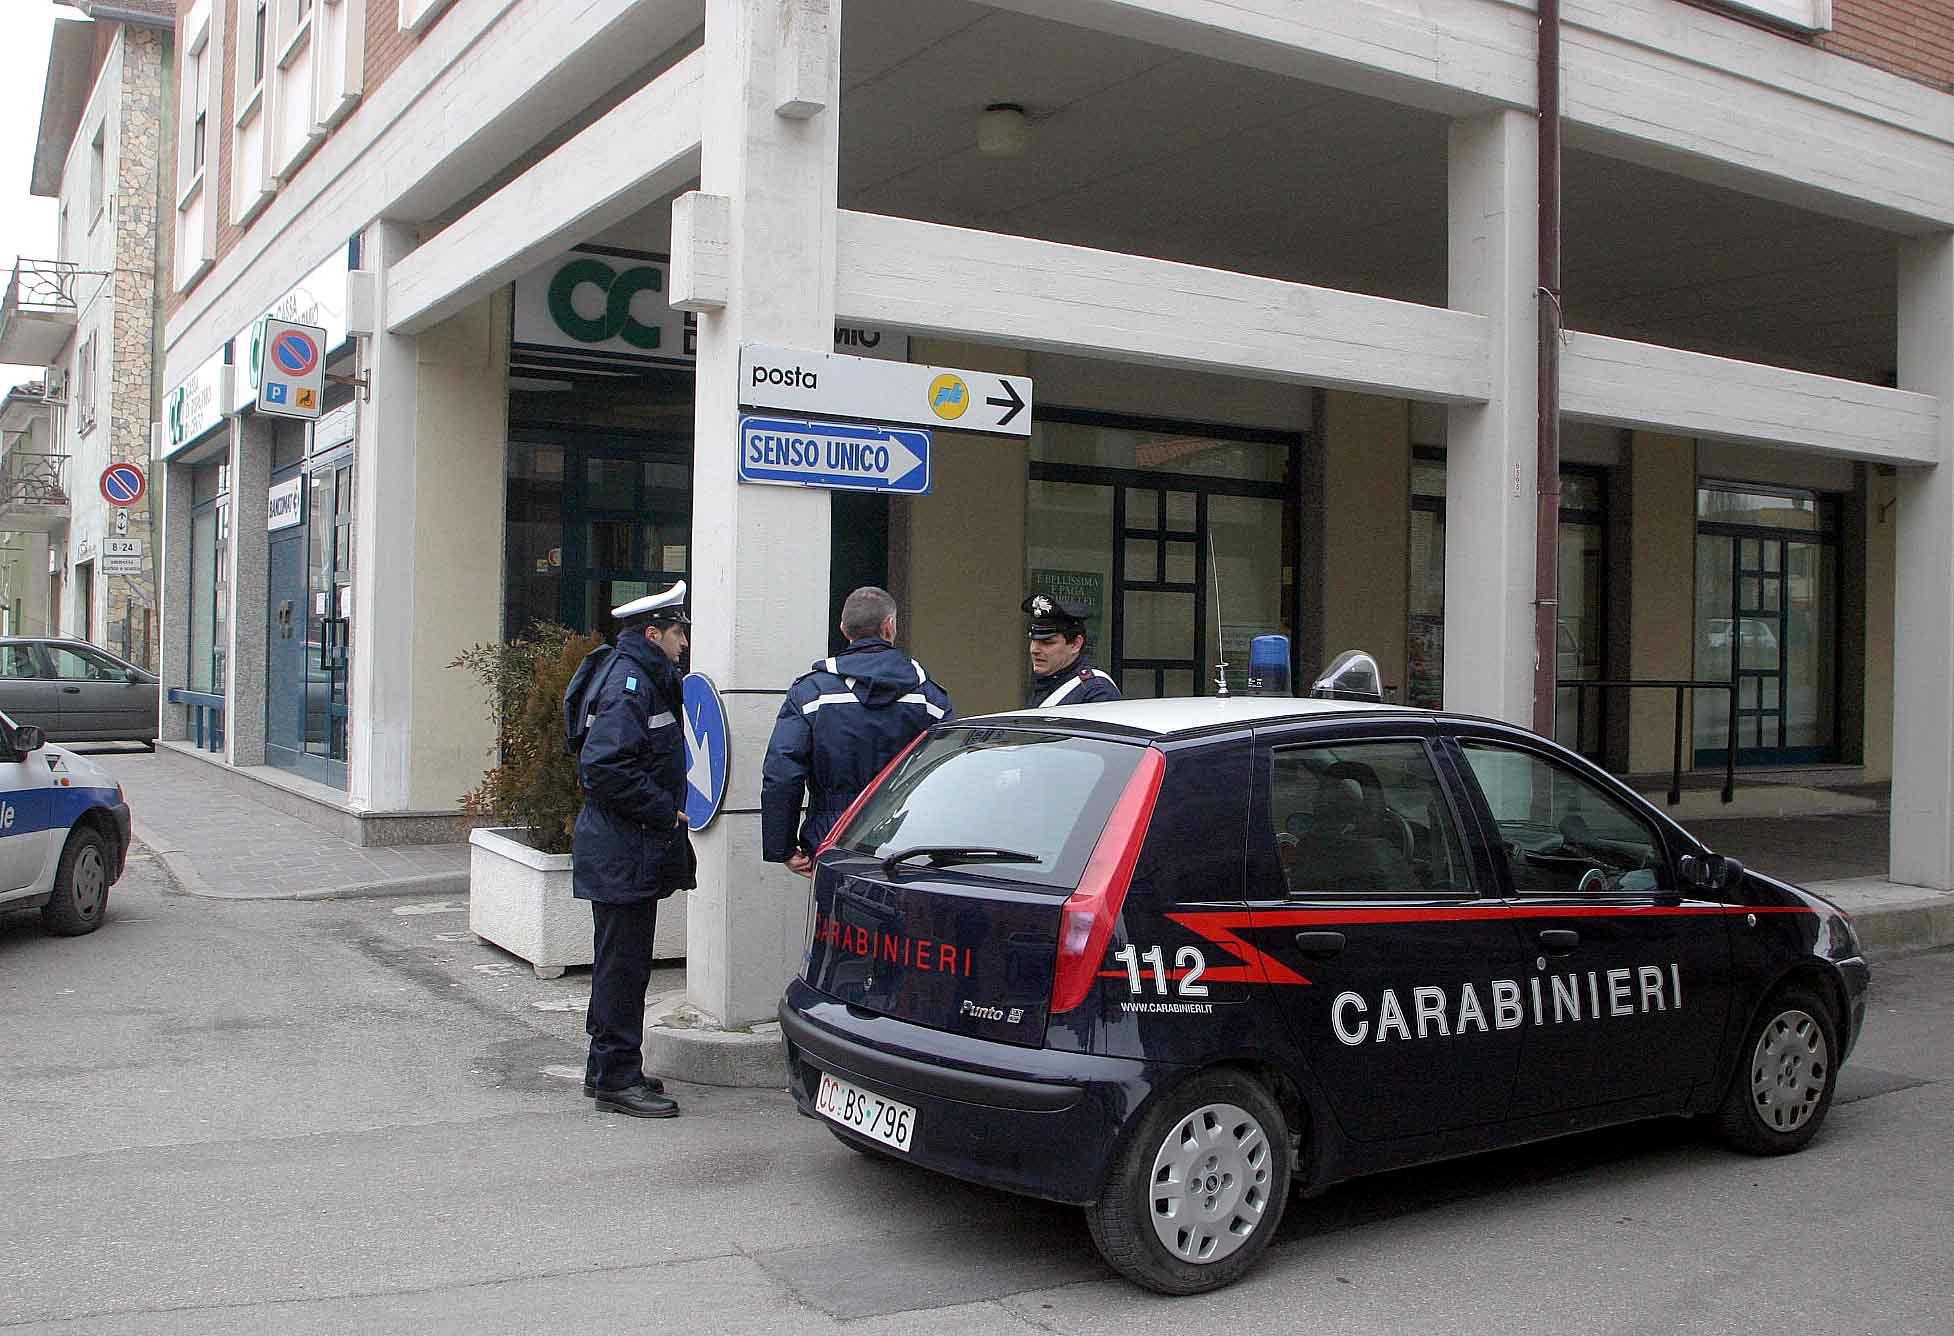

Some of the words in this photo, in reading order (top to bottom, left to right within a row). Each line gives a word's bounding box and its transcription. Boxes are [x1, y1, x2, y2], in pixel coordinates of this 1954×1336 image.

[752, 365, 817, 389] posta
[750, 434, 820, 467] SENSO
[826, 440, 890, 473] UNICO
[815, 912, 974, 977] CARABINIERI
[1115, 944, 1209, 996] 112
[960, 999, 1004, 1021] Punto
[1120, 1001, 1213, 1014] WWW.CARABINIERI.IT
[1331, 962, 1682, 1046] CARABINIERI
[819, 1077, 840, 1113] CC
[843, 1088, 866, 1126] BS
[871, 1099, 910, 1144] 796
